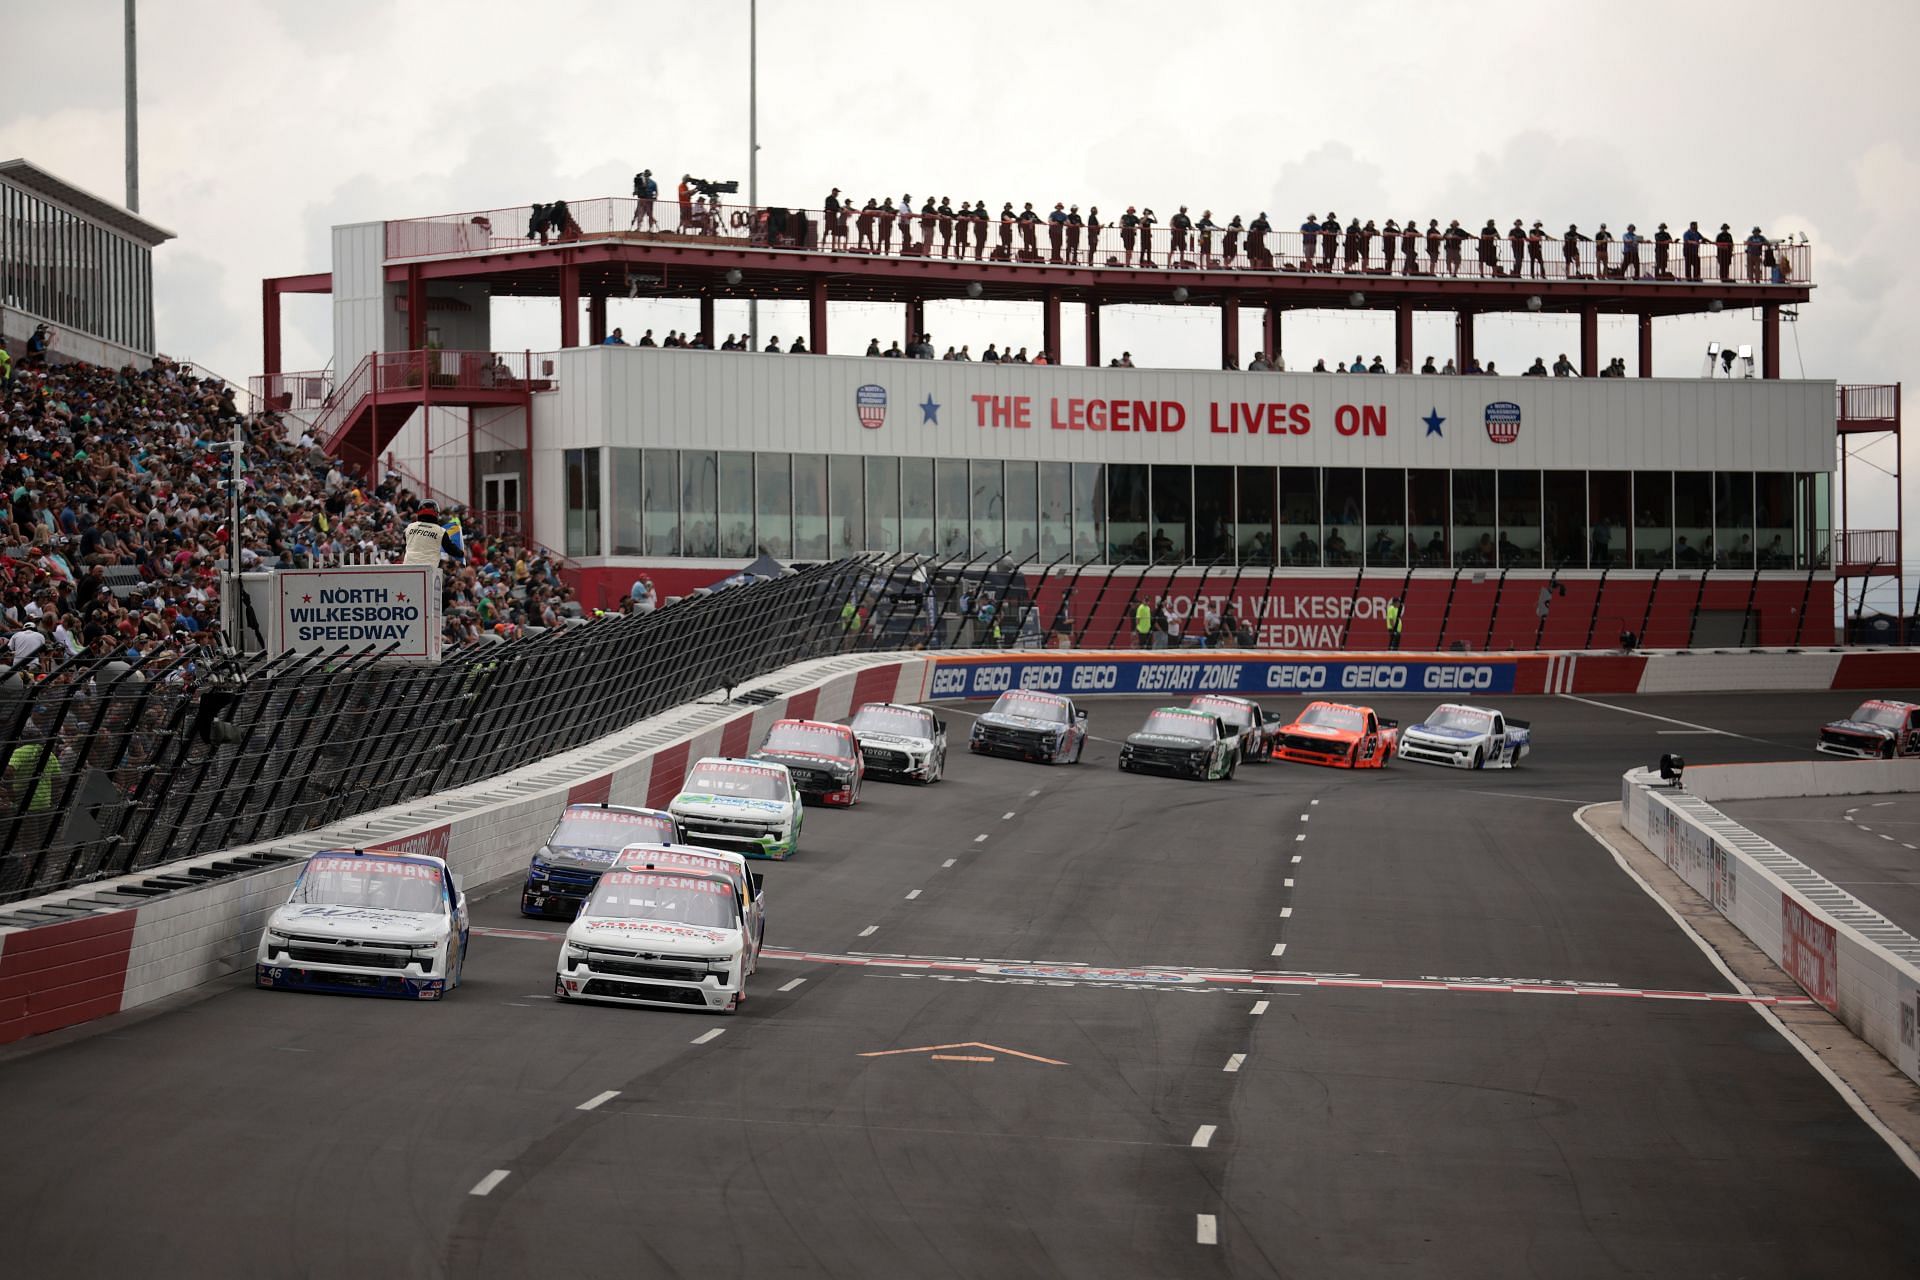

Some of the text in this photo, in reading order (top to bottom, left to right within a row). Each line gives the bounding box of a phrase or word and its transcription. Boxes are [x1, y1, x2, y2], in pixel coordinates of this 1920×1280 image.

[971, 394, 1387, 437] THE LEGEND LIVES ON
[409, 528, 438, 540] OFFICIAL
[320, 588, 388, 604] NORTH
[290, 606, 419, 623] WILKESBORO
[299, 624, 410, 641] SPEEDWAY
[1253, 623, 1344, 648] EEDWAY
[933, 664, 1493, 693] GEICO GEICO GEICO GEICO RESTART ZONE GEICO GEICO GEICO
[864, 747, 892, 757] TOYOTA
[701, 762, 780, 779] CRAFTSMAN
[792, 768, 812, 778] YOTA
[572, 810, 665, 830] CRAFTSMAN
[316, 858, 430, 879] CRAFTSMAN
[626, 849, 730, 872] CRAFTSMAN
[610, 874, 722, 894] CRAFTSMAN
[268, 967, 282, 979] 46
